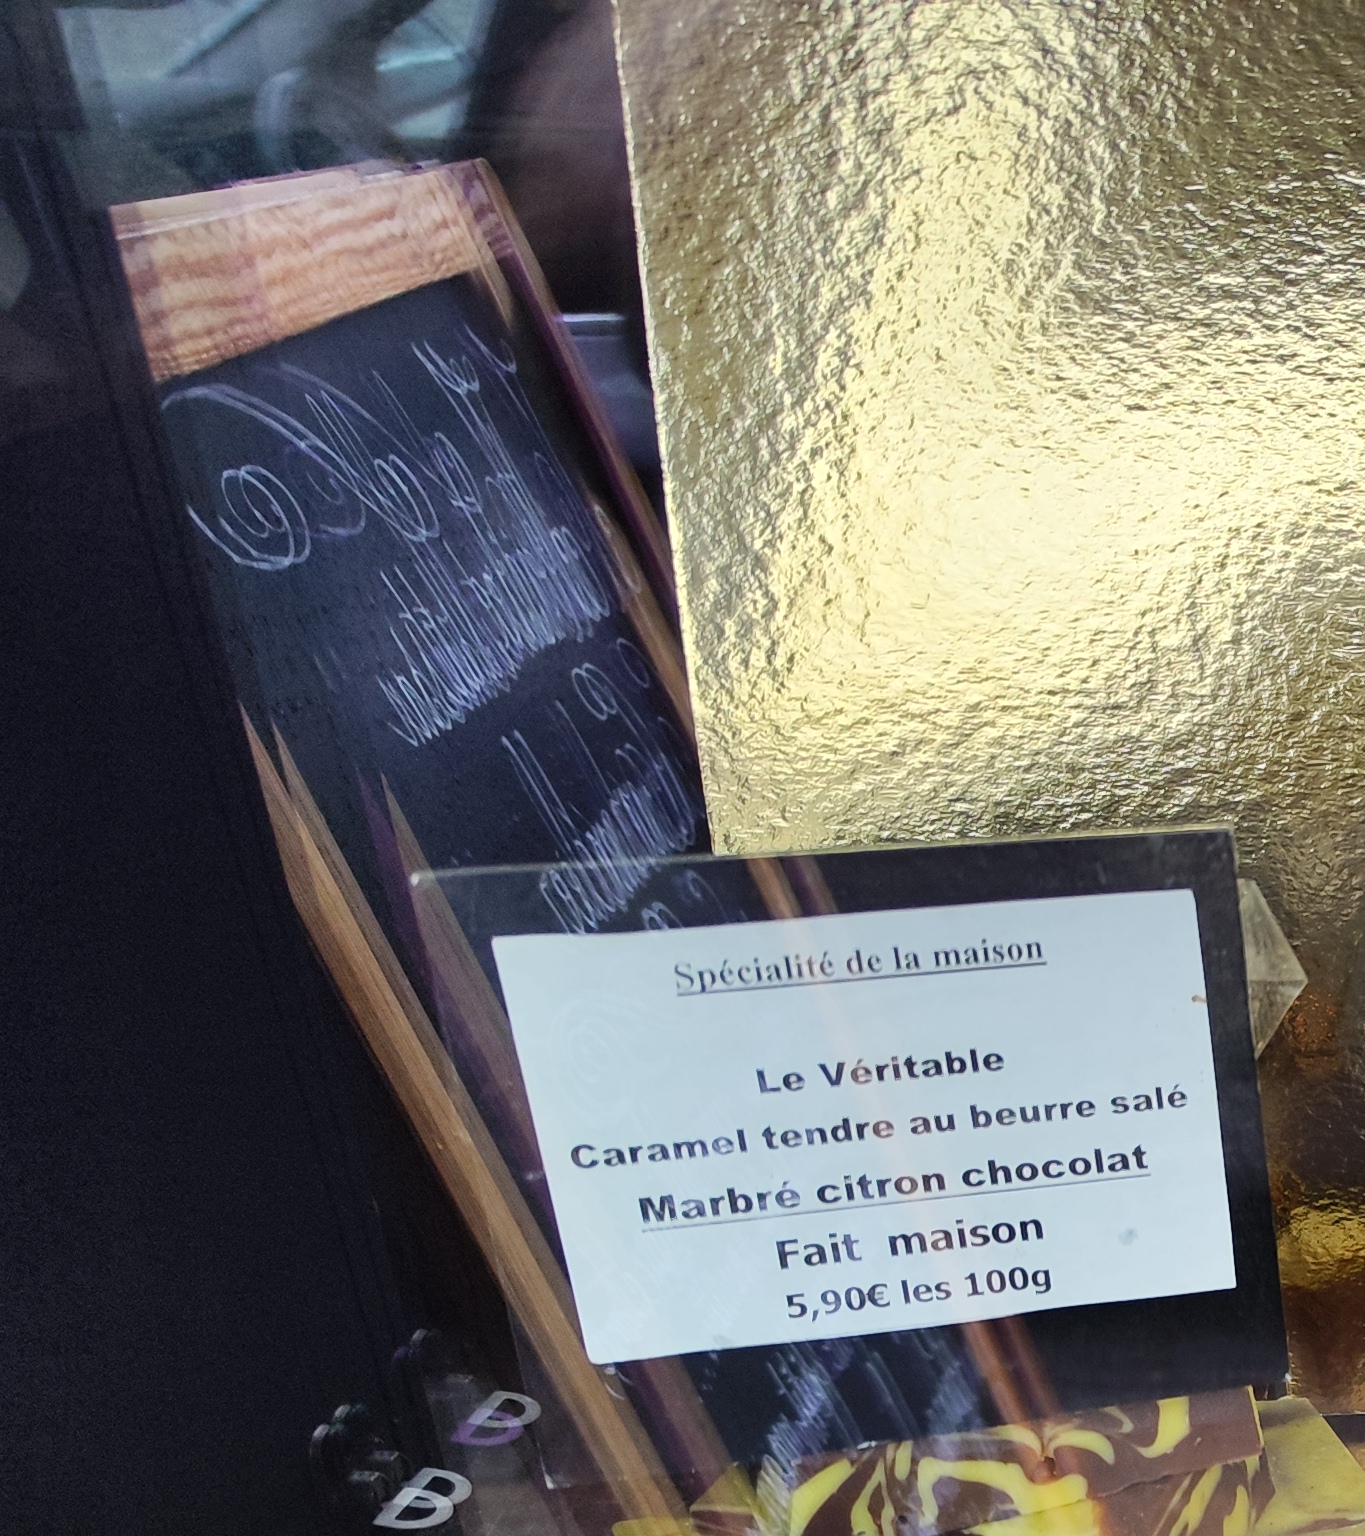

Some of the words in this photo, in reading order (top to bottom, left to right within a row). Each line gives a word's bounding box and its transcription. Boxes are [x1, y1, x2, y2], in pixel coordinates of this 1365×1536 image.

[674, 951, 835, 993] Spécialité
[845, 949, 883, 975] de
[892, 945, 922, 973] la
[933, 936, 1044, 969] maison
[756, 1067, 805, 1094] Le
[818, 1047, 1006, 1088] Véritable
[570, 1128, 748, 1170] Caramel
[762, 1115, 895, 1150] tendre
[910, 1111, 956, 1137] au
[970, 1095, 1097, 1132] beurre
[1110, 1085, 1189, 1115] salé
[638, 1180, 801, 1224] Marbré
[815, 1168, 947, 1204] citron
[961, 1144, 1149, 1189] chocolat
[775, 1232, 862, 1270] Fait
[888, 1216, 1045, 1258] maison
[786, 1283, 892, 1324] 5,90€
[901, 1277, 951, 1305] les
[963, 1266, 1053, 1299] 100g
